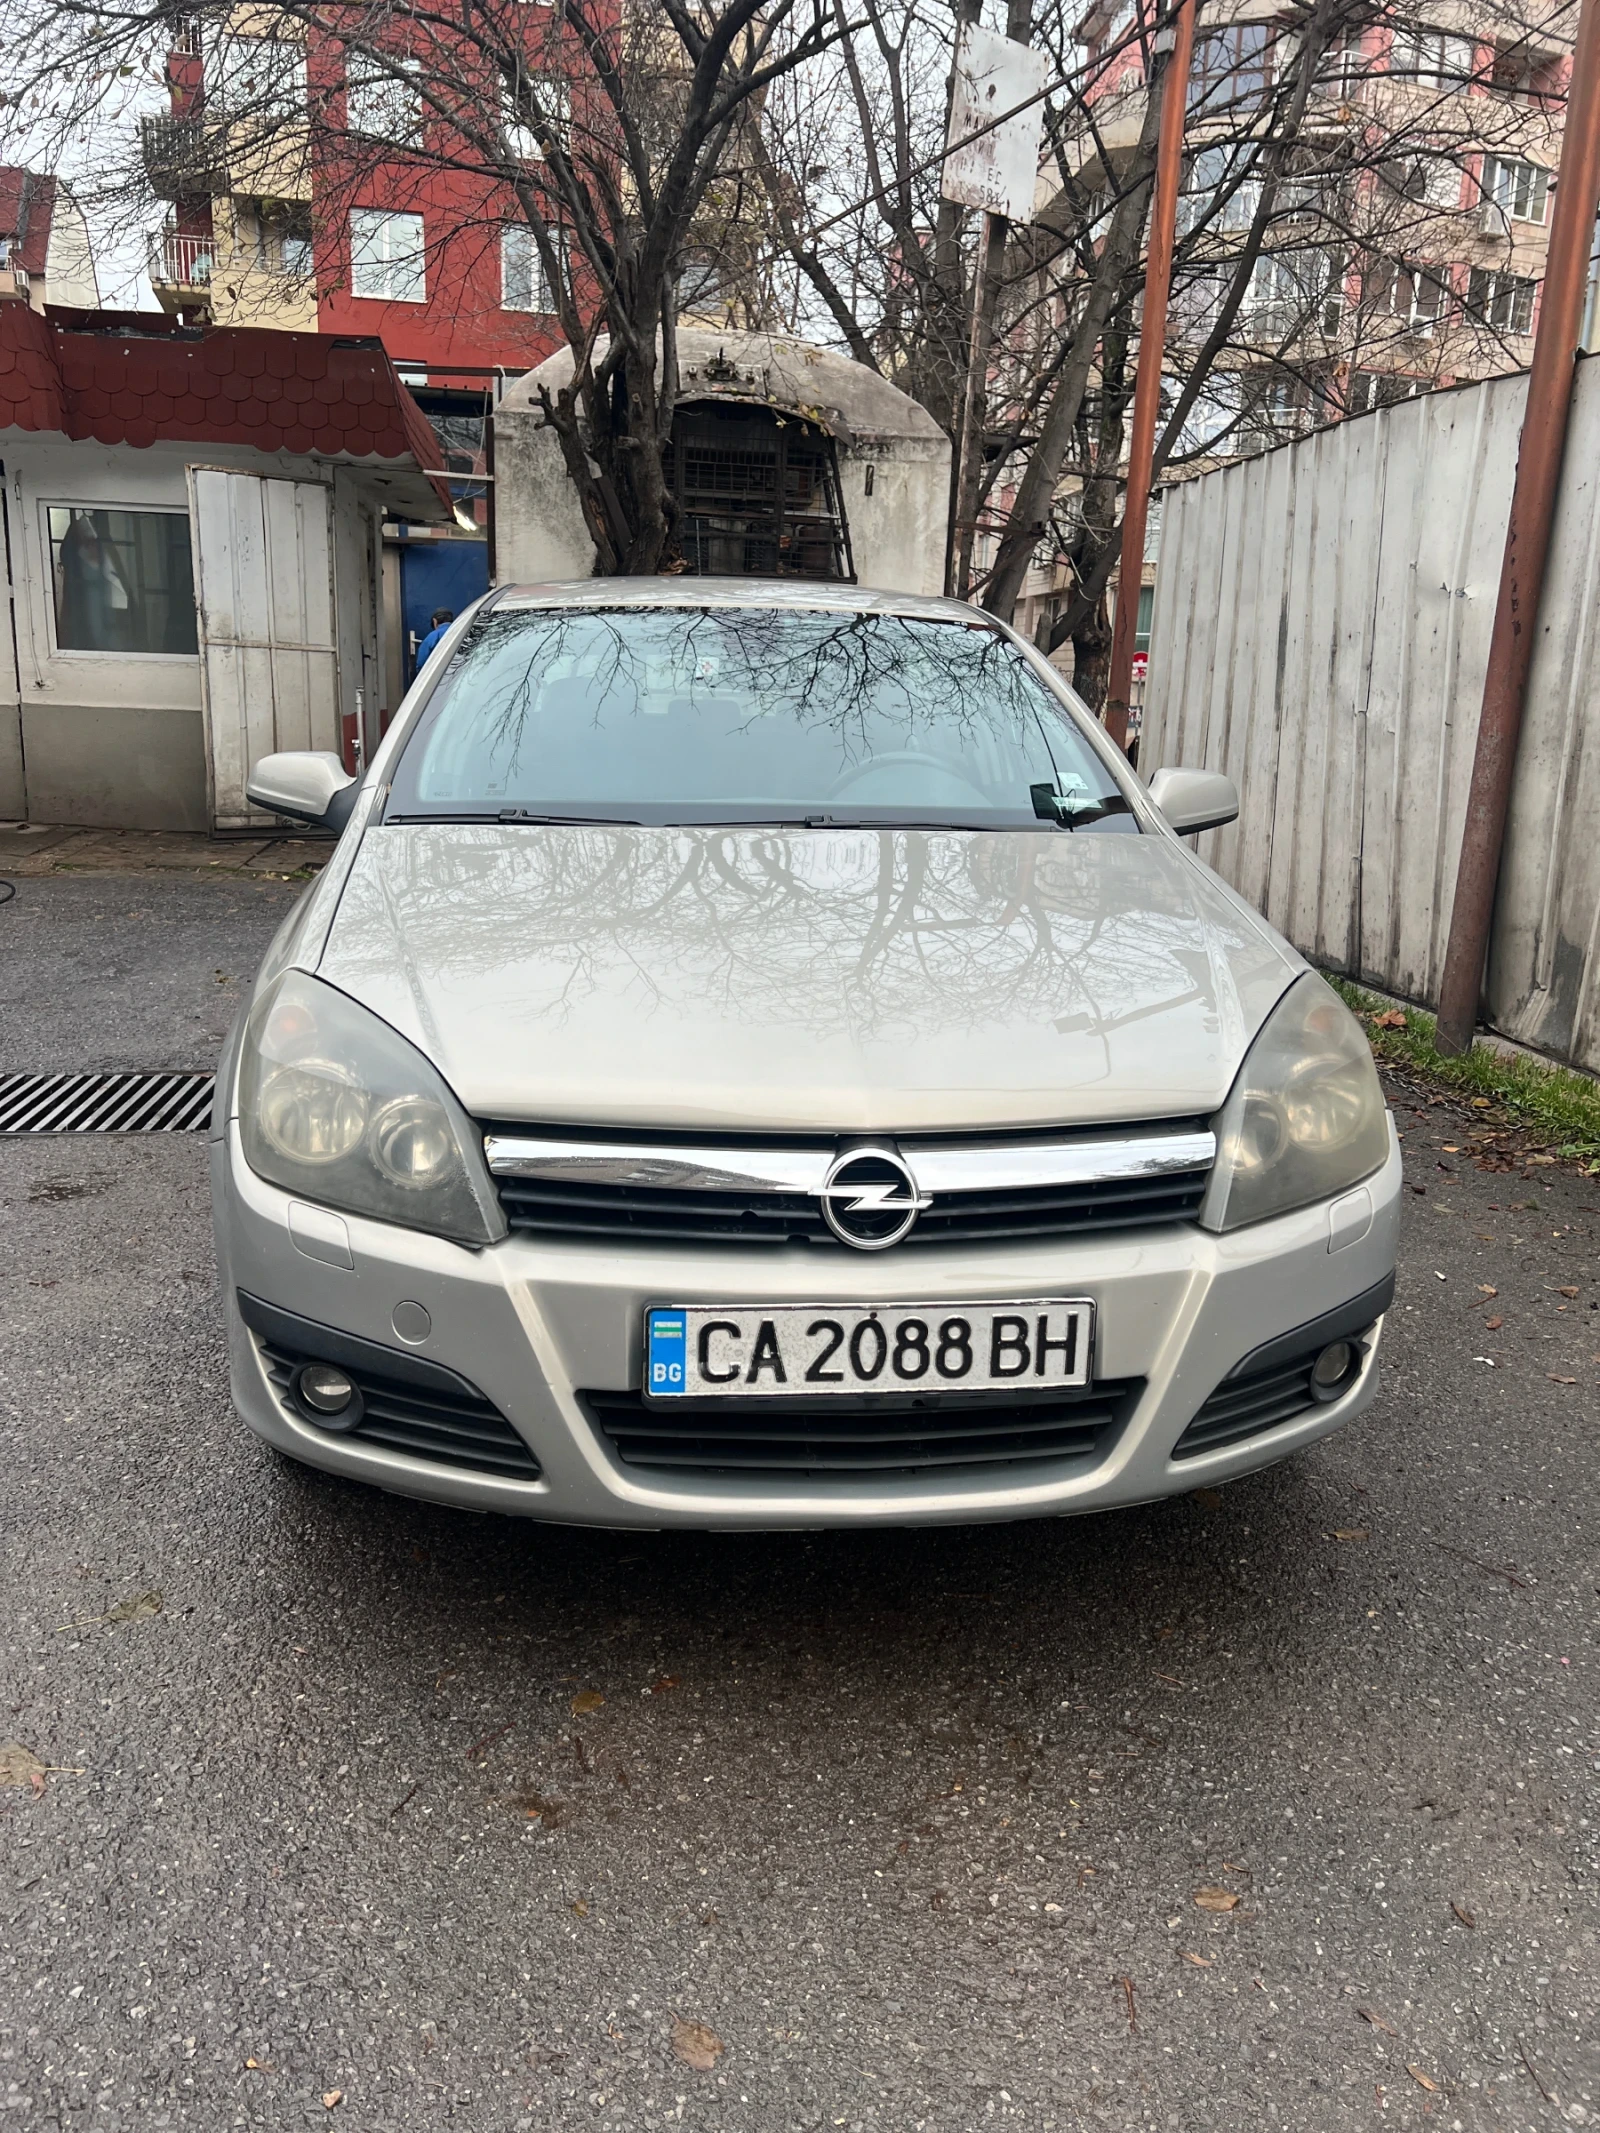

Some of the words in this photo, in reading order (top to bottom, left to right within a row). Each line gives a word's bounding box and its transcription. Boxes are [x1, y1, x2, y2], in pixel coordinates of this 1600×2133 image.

[698, 1318, 788, 1383] CA
[805, 1315, 973, 1382] 2088
[989, 1313, 1079, 1378] BH
[653, 1363, 683, 1383] BG
